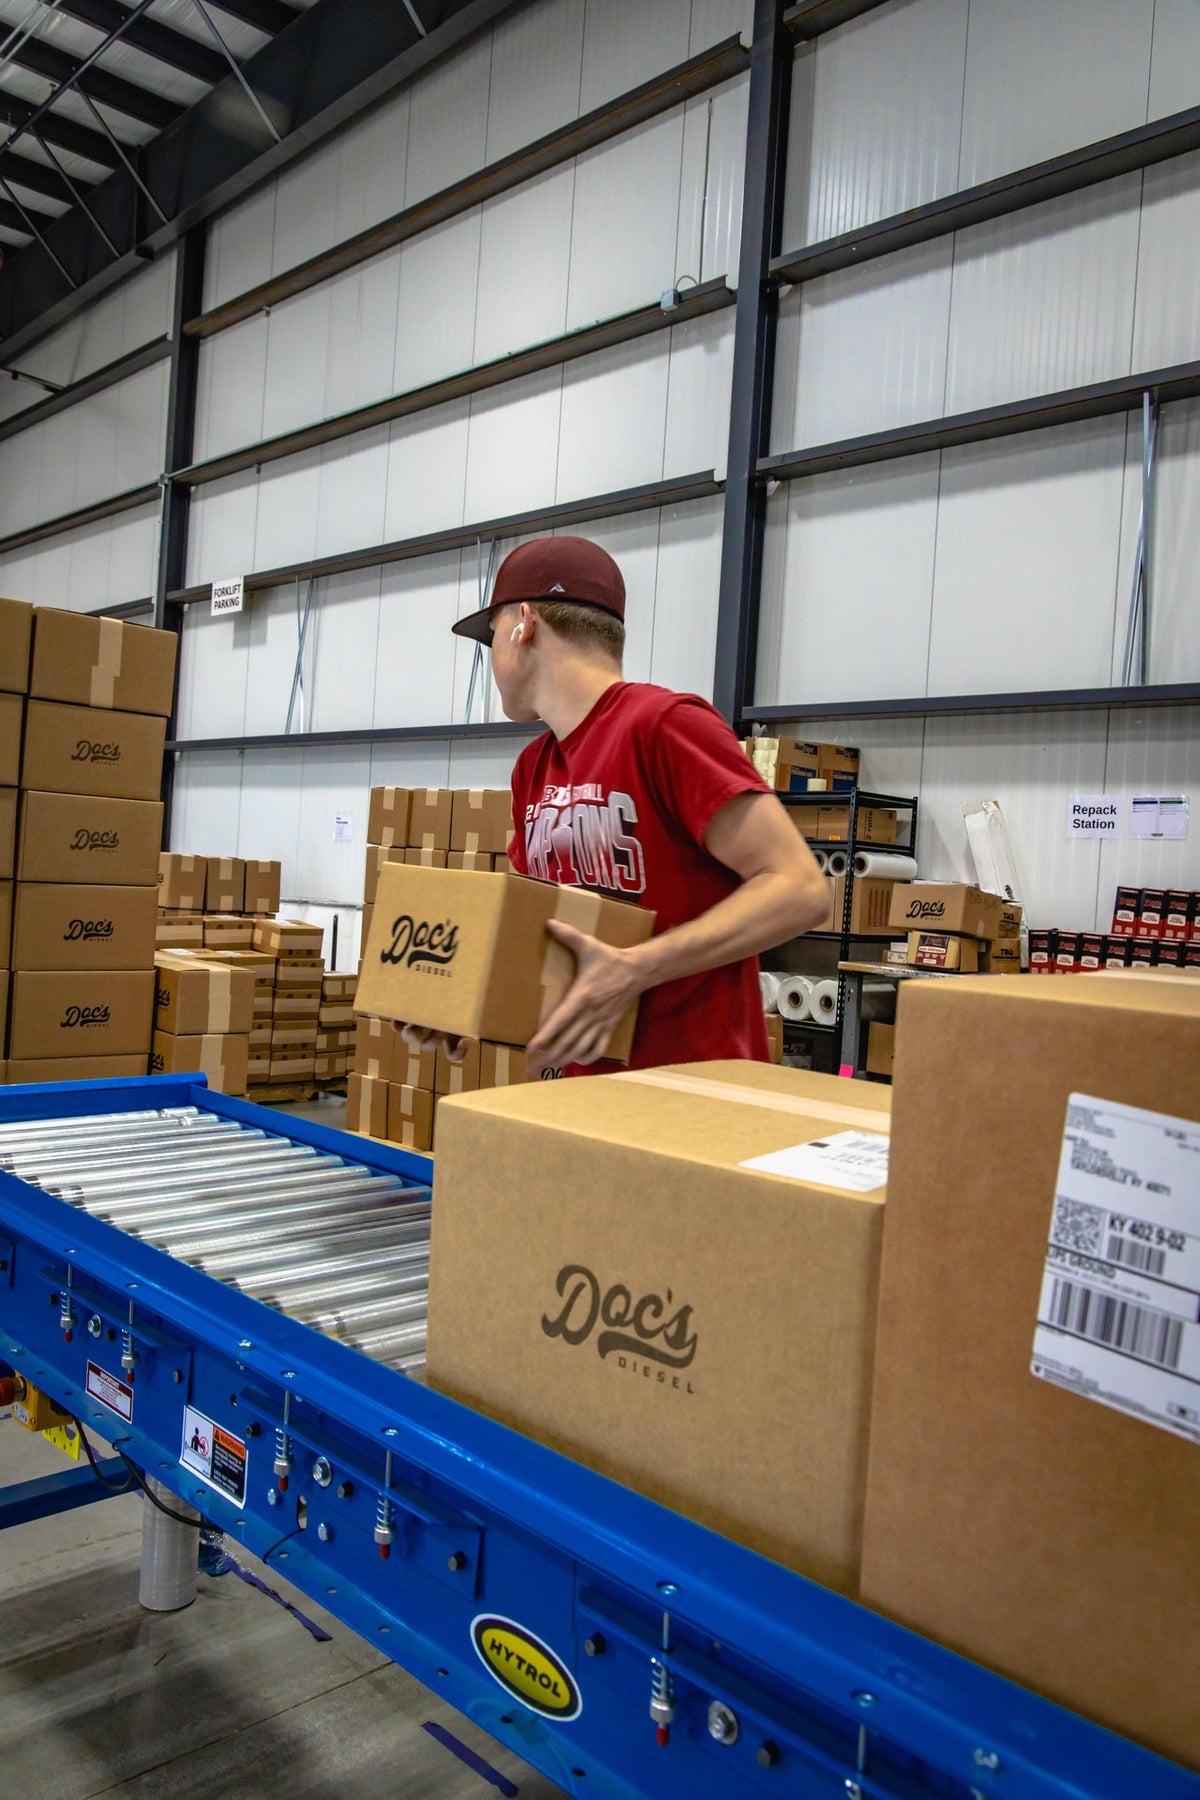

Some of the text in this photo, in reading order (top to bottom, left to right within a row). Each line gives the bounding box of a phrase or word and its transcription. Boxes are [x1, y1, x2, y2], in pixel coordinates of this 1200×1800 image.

[214, 584, 241, 598] FORKLIFT
[214, 597, 240, 609] PARKING
[71, 740, 121, 762] Doc's
[1072, 805, 1117, 816] Repack
[1072, 818, 1115, 829] Station
[70, 829, 119, 851] Doc's
[906, 899, 945, 919] Doc's
[63, 918, 113, 941] Doc's
[381, 914, 459, 968] Doc's
[415, 964, 452, 977] DIESEL
[61, 1004, 111, 1028] Doc's
[1109, 1216, 1127, 1232] KY
[1069, 1253, 1116, 1280] GROUND
[541, 1264, 698, 1368] Doc's
[618, 1356, 694, 1394] DIESEL
[489, 1638, 561, 1698] HYTROL
